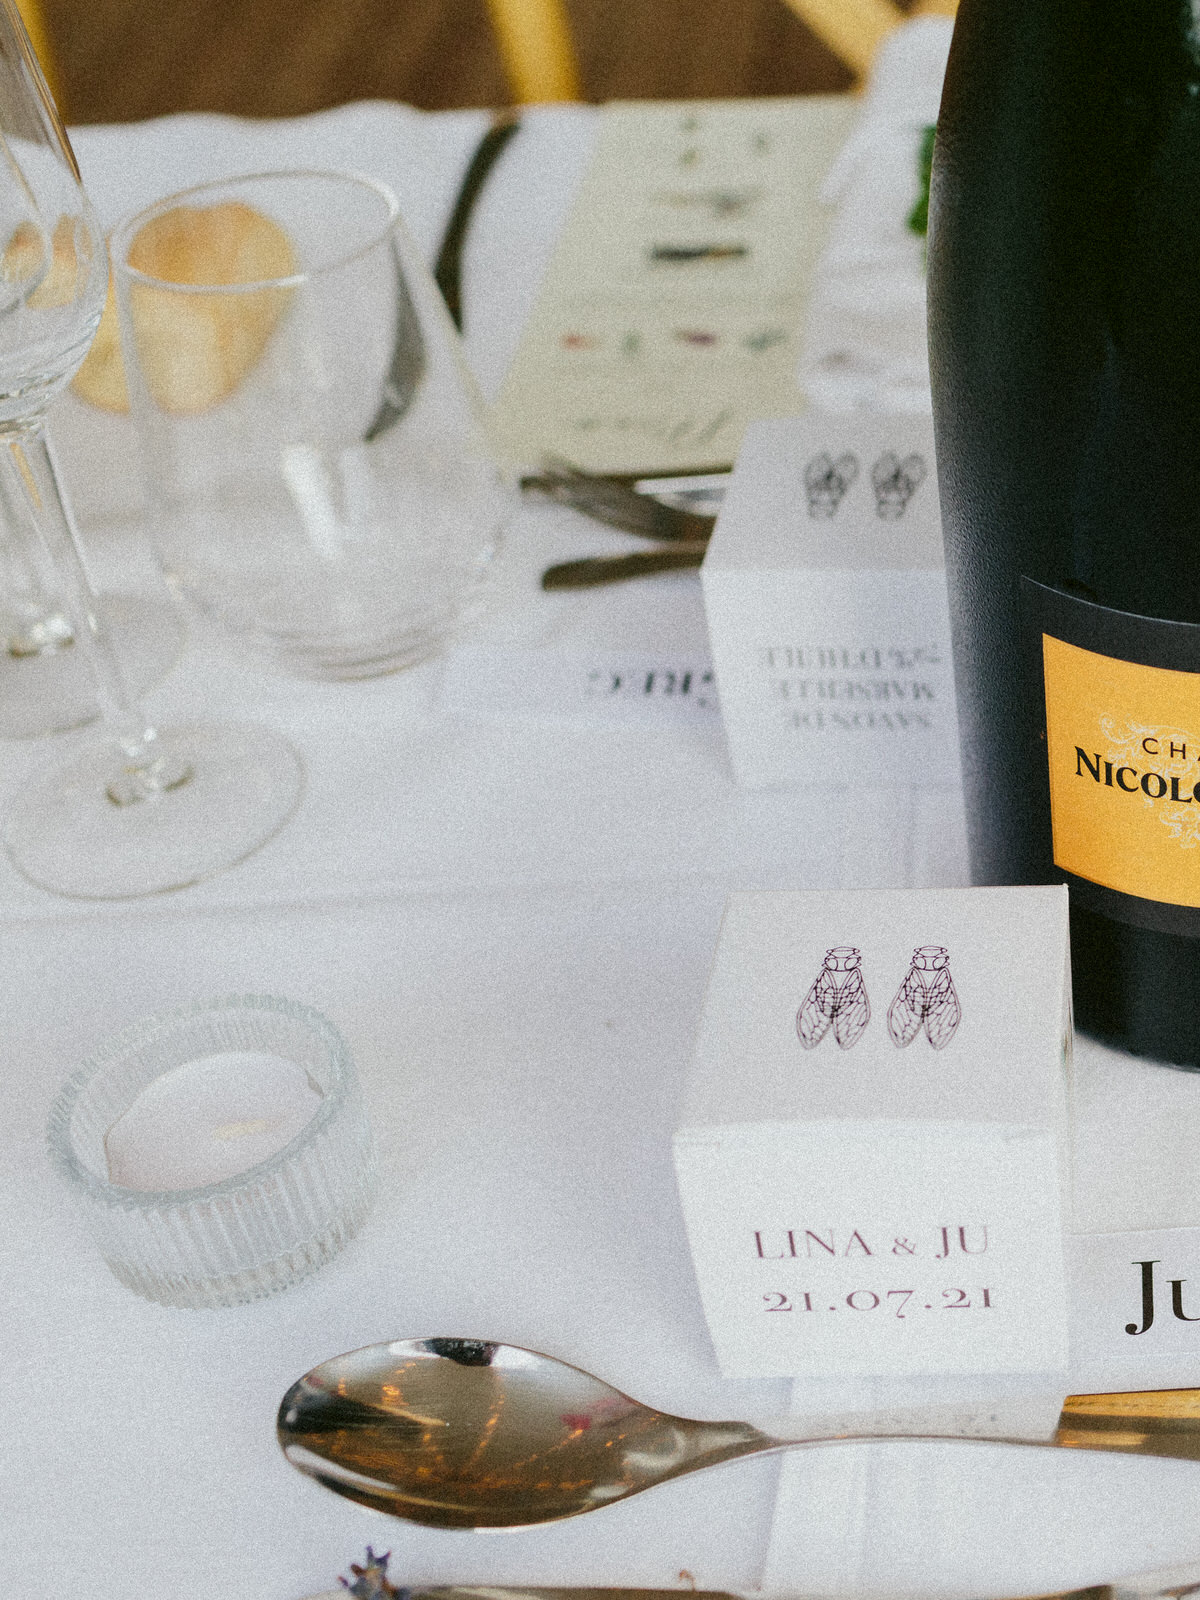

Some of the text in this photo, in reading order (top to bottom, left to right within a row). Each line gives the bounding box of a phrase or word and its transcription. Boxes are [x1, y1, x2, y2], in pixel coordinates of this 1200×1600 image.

[753, 1225, 990, 1260] LINA & JU
[762, 1287, 994, 1319] 21.07.21
